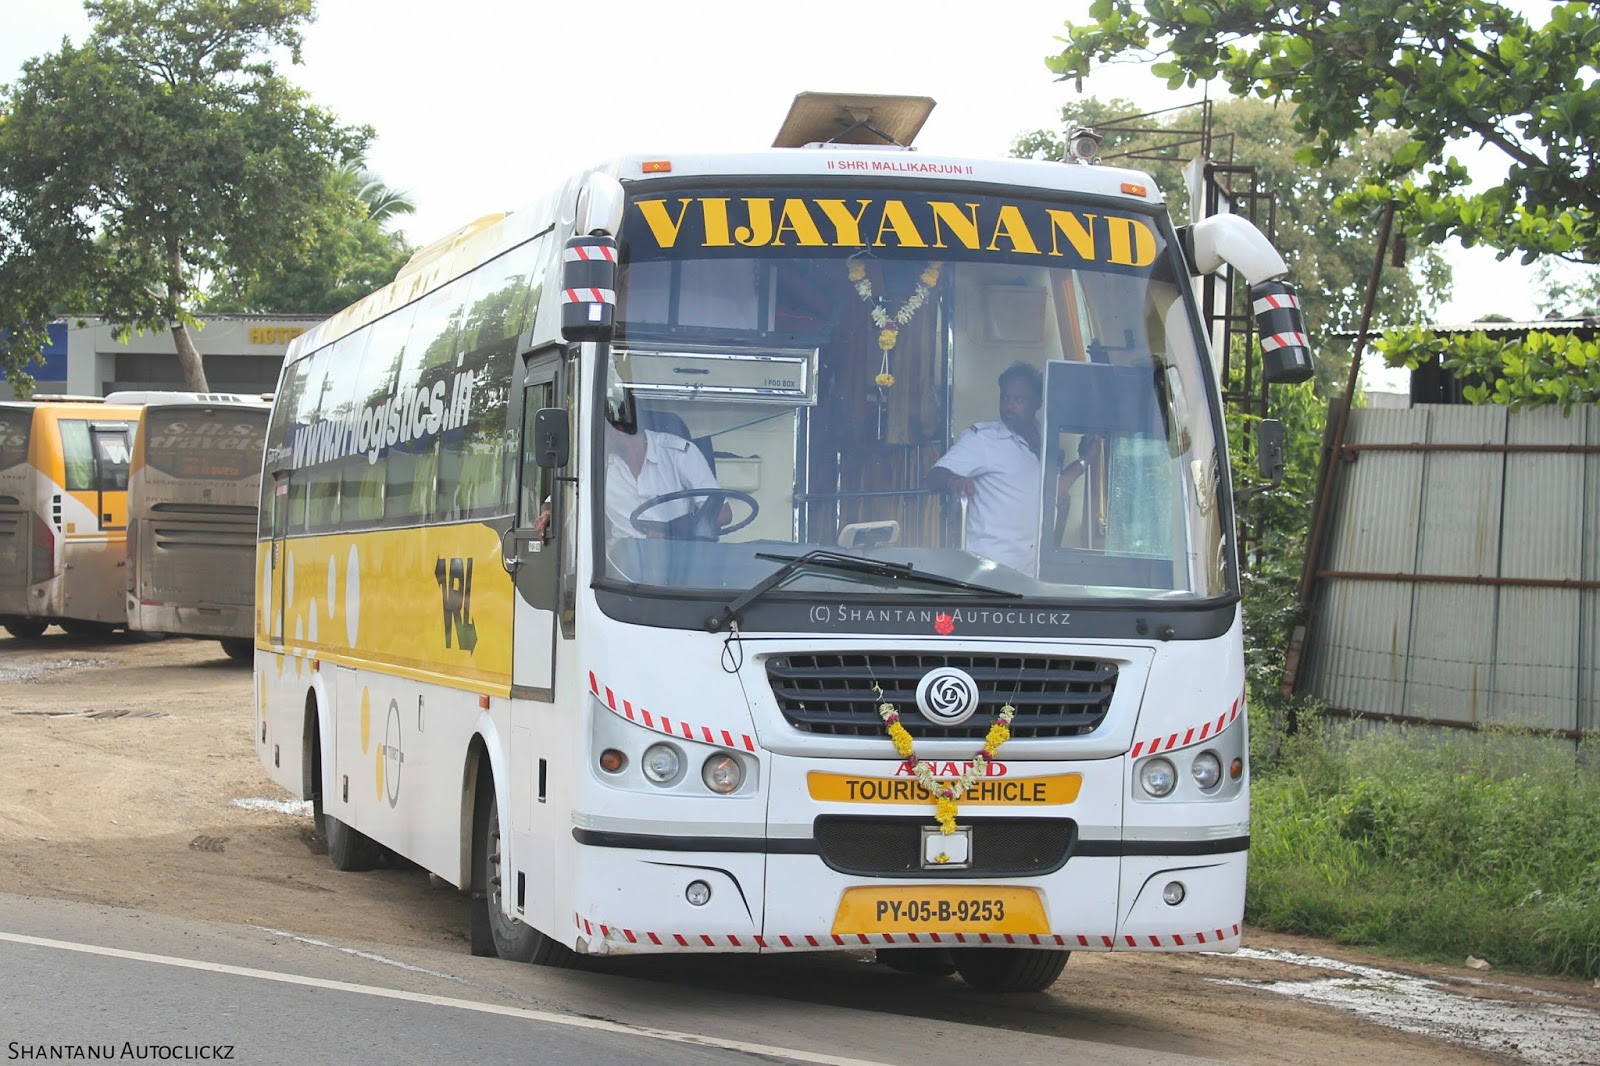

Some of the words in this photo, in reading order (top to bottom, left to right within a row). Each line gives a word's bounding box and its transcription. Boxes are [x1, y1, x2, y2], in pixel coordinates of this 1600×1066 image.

[838, 160, 868, 170] SHRI
[872, 161, 962, 174] MALLIKARJUN
[634, 197, 1156, 267] VIJAYANAND
[768, 379, 781, 387] POD
[782, 380, 795, 388] BOX
[846, 781, 944, 799] TOURIS
[951, 781, 1047, 802] EHICLE
[876, 900, 1005, 922] PY-05-B-9253
